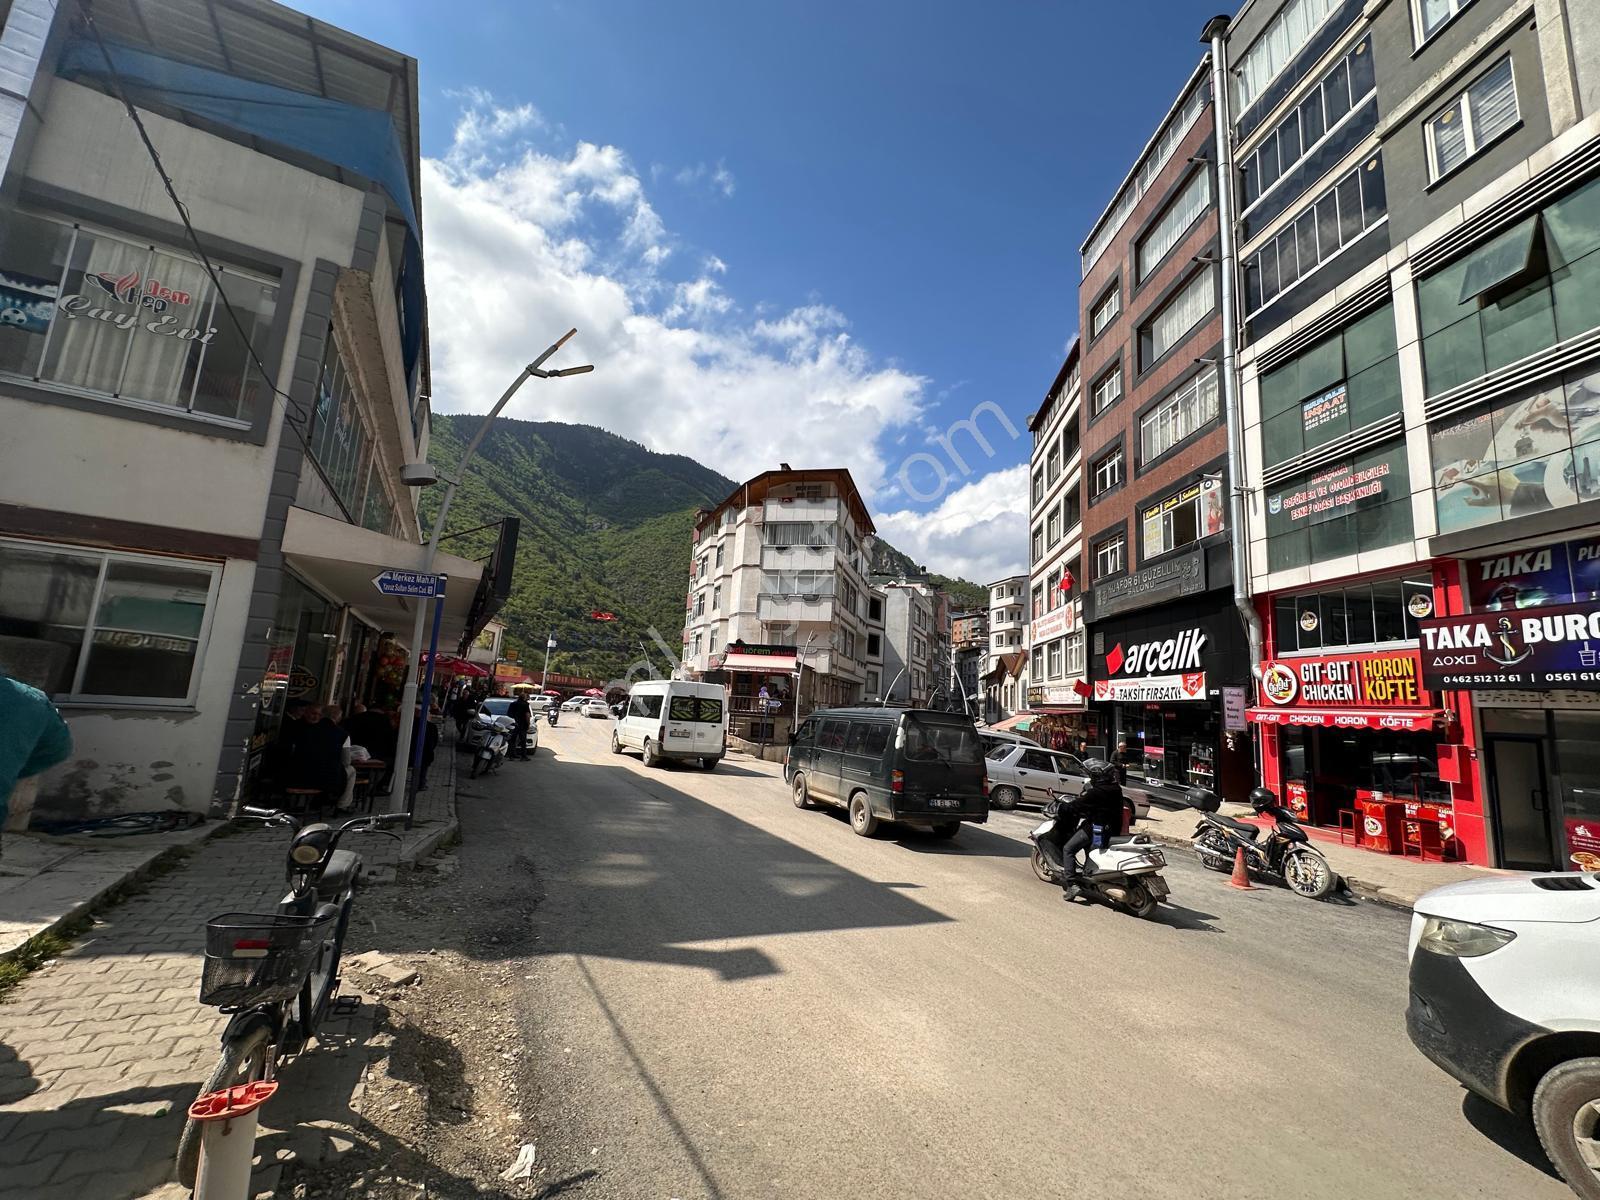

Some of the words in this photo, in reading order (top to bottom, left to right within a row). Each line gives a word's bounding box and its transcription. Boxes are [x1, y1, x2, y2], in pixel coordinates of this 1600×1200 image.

[127, 287, 168, 313] Hep
[143, 278, 192, 305] Dem
[59, 294, 139, 329] Çay
[147, 315, 219, 344] Evi
[1290, 504, 1313, 520] ESNAF
[1313, 498, 1335, 512] ODASI
[1335, 481, 1382, 505] BAŞKANLIĞI
[1317, 486, 1328, 497] VE
[1481, 549, 1553, 581] TAKA
[392, 571, 415, 583] Merkez
[1421, 623, 1493, 650] TAKA
[1301, 661, 1350, 682] GIT-GIT
[1363, 658, 1415, 677] HORON
[1452, 675, 1471, 683] 462
[1474, 674, 1492, 683] 512
[1493, 674, 1506, 683] 12
[1508, 674, 1521, 682] 61
[1545, 672, 1577, 682] 0561
[1109, 688, 1115, 699] 9
[1119, 684, 1146, 700] TAKSİT
[1146, 686, 1182, 700] FIRSATI!
[1302, 684, 1354, 701] CHICKEN
[1365, 677, 1418, 700] KÖFTE
[1289, 715, 1324, 724] CHICKEN
[1334, 716, 1368, 725] HORON
[1379, 715, 1414, 727] KÖFTE
